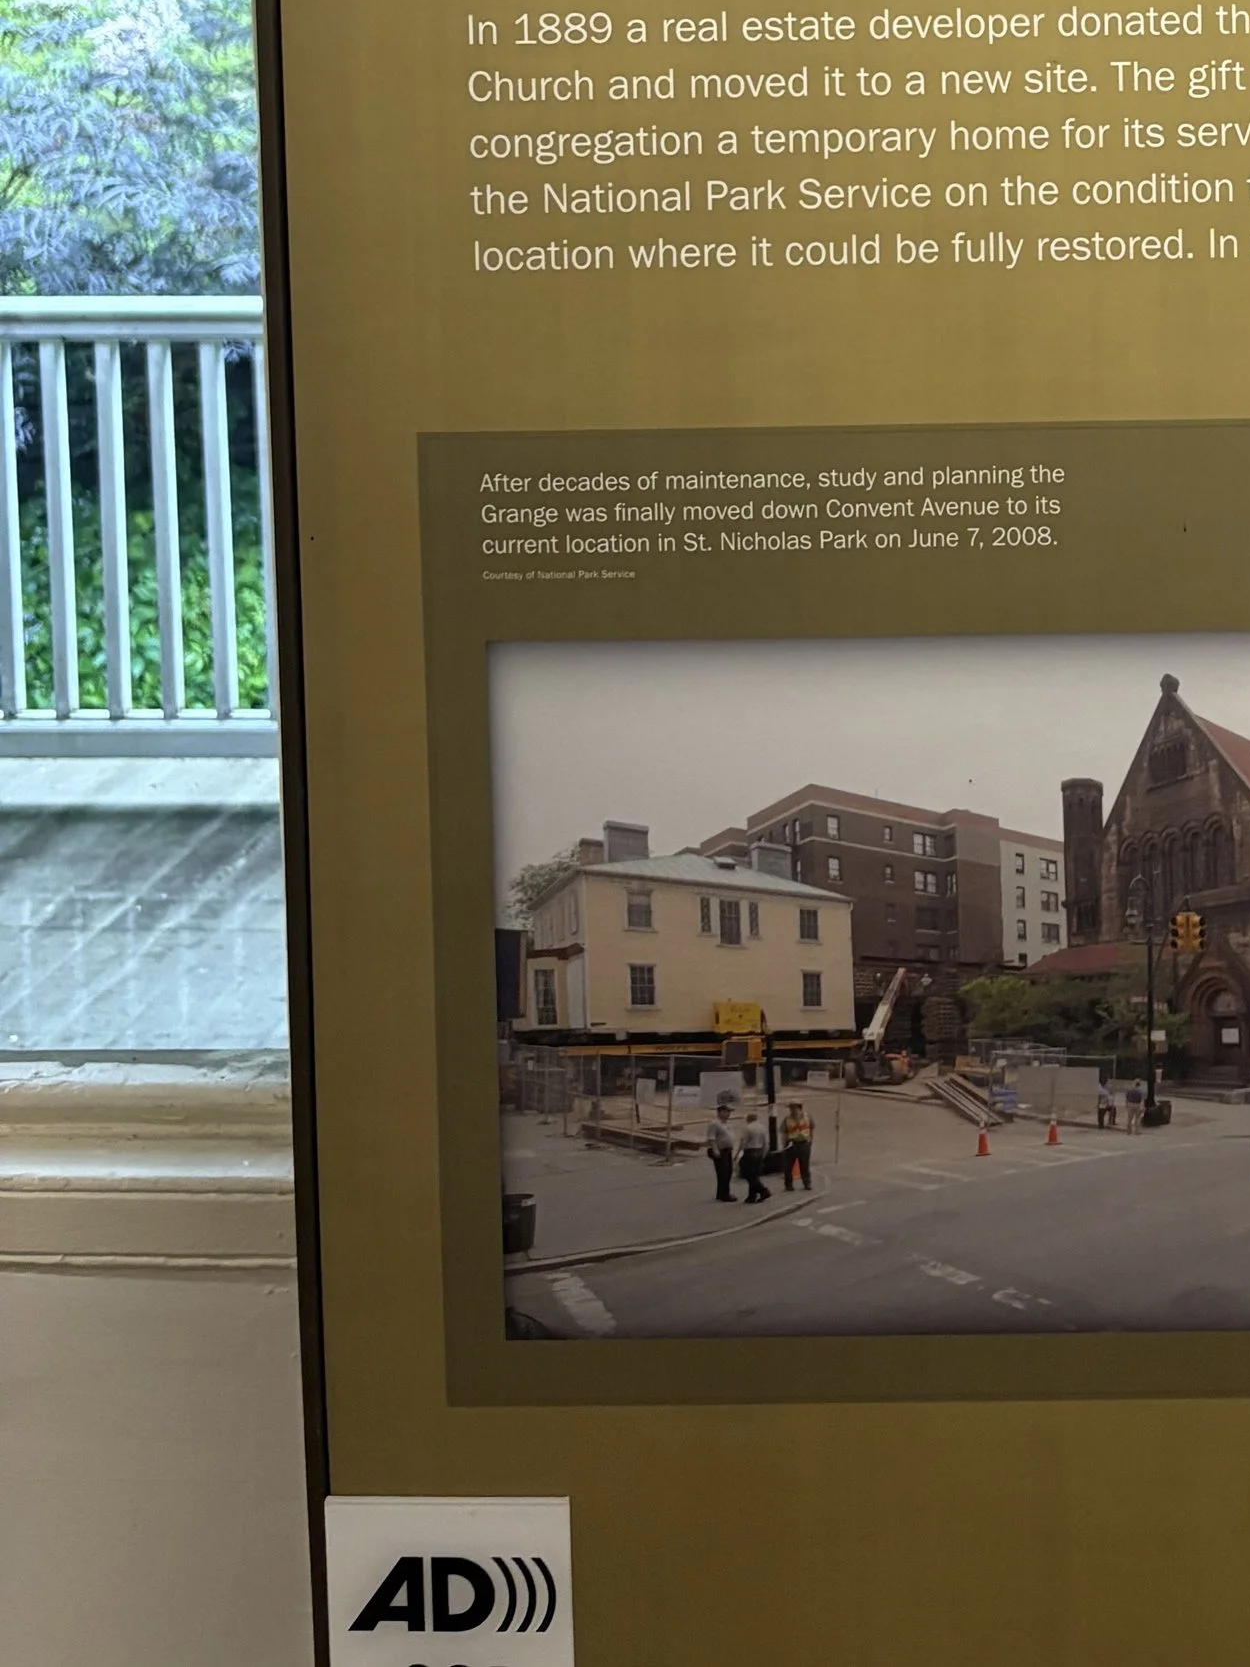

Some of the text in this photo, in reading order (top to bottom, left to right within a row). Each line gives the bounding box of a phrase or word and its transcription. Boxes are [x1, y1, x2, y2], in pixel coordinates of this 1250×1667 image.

[468, 15, 497, 45] In
[515, 12, 612, 44] 1889
[627, 19, 646, 43] a
[663, 11, 727, 42] real
[742, 12, 855, 41] estate
[870, 8, 1045, 44] developer
[1058, 4, 1202, 36] donated
[469, 70, 593, 102] Church
[609, 68, 674, 100] and
[691, 66, 807, 98] moved
[824, 66, 846, 96] it
[856, 67, 891, 96] to
[905, 71, 924, 95] a
[942, 71, 1011, 94] new
[1025, 63, 1096, 93] site.
[1110, 61, 1175, 91] The
[1189, 59, 1246, 98] gift
[470, 125, 702, 165] congregation
[718, 131, 737, 154] a
[751, 125, 936, 159] temporary
[951, 120, 1049, 150] home
[1061, 118, 1110, 148] for
[1124, 118, 1164, 148] its
[470, 184, 528, 215] the
[544, 181, 690, 213] National
[707, 180, 786, 210] Park
[799, 178, 931, 209] Service
[945, 183, 987, 207] on
[1001, 175, 1058, 206] the
[1073, 173, 1233, 204] condition
[475, 239, 613, 271] location
[628, 238, 736, 268] where
[752, 236, 773, 266] it
[786, 234, 880, 266] could
[897, 233, 939, 263] be
[951, 232, 1023, 269] fully
[1038, 229, 1193, 261] restored.
[1210, 228, 1238, 258] In
[480, 464, 1064, 492] After decades of maintenance, study and planning the
[482, 496, 1060, 527] Grange was finally moved down Convent Avenue to its
[483, 526, 1057, 554] current location in St. Nicholas Park on June 7, 2008.
[482, 569, 635, 581] Courtesy of National Park Service
